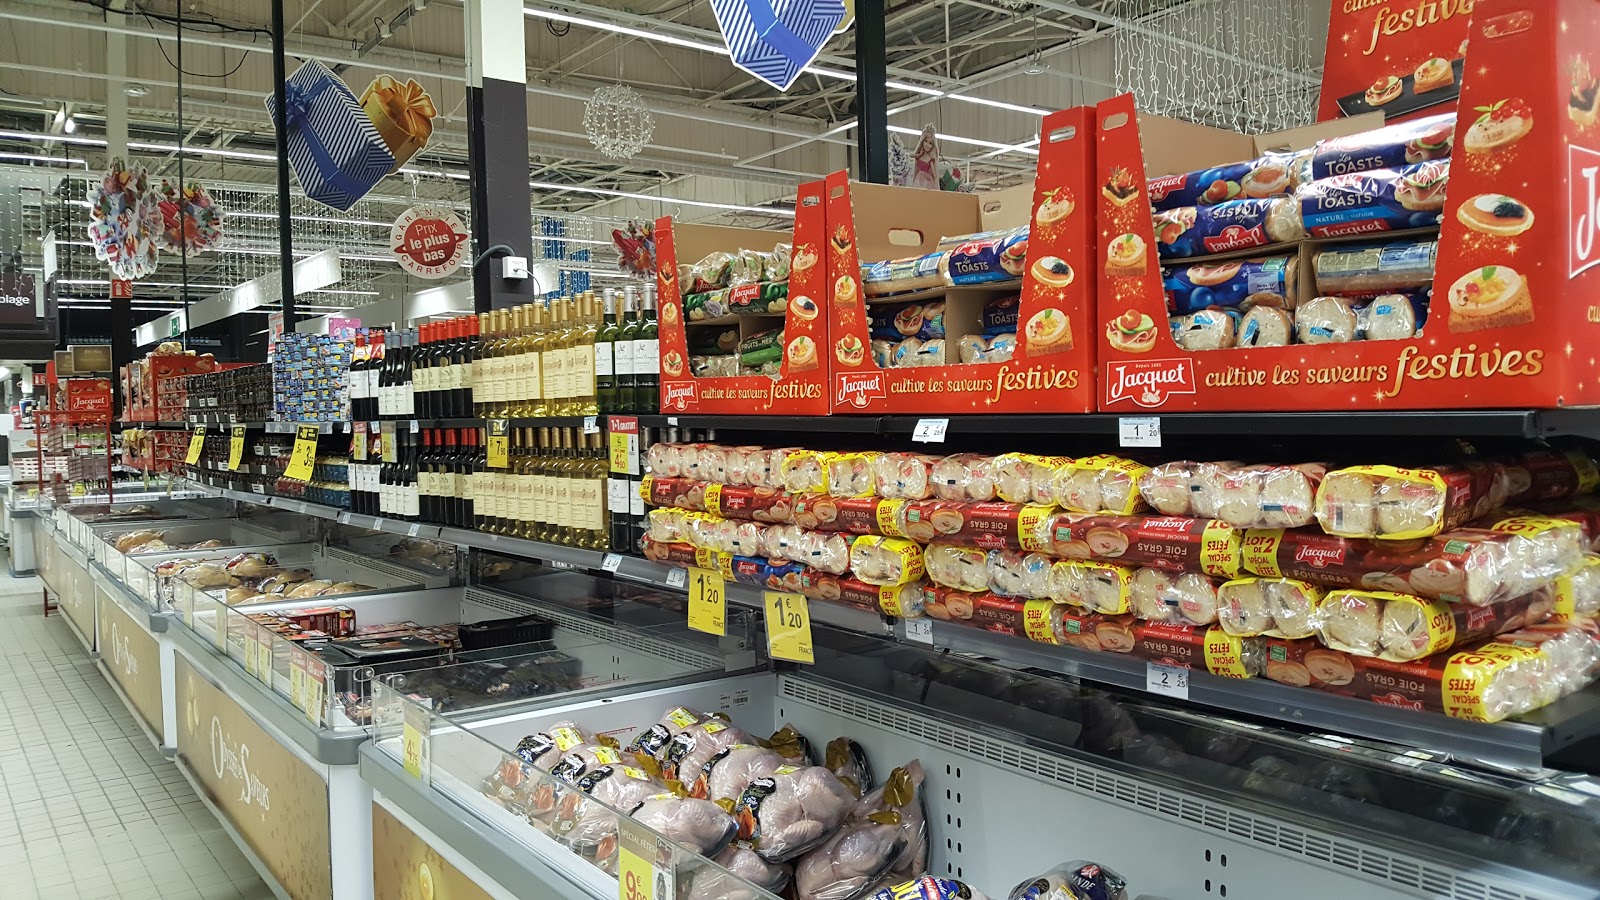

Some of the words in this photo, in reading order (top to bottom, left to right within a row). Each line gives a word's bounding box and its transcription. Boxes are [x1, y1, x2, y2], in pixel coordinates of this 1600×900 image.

[1325, 155, 1384, 176] TOASTS
[1147, 174, 1185, 193] acquet
[1315, 191, 1373, 210] TOASTS
[1213, 203, 1260, 220] TOASTS
[1315, 213, 1345, 224] NATURE
[415, 223, 438, 236] Prix
[1210, 223, 1263, 250] Jacquet
[410, 238, 422, 250] le
[424, 232, 450, 250] plus
[401, 243, 464, 275] CARREFOUR
[422, 249, 446, 263] bas
[955, 260, 990, 273] TOASTS
[730, 286, 758, 302] Jacquet
[1205, 365, 1267, 387] cultive
[1271, 364, 1300, 385] les
[1305, 364, 1388, 384] saveurs
[1385, 343, 1544, 398] festives
[890, 377, 926, 394] cultive
[927, 376, 944, 392] les
[946, 377, 994, 392] saveurs
[990, 364, 1080, 404] festives
[1110, 362, 1187, 399] Jacquet
[665, 385, 695, 405] Jacquet
[700, 386, 725, 400] cultive
[725, 385, 737, 399] les
[738, 388, 768, 399] saveurs
[768, 379, 823, 408] festives
[838, 375, 880, 402] Jacquet
[73, 396, 105, 409] Jacquet
[922, 426, 930, 435] 2
[1133, 424, 1140, 437] 1
[1148, 429, 1158, 437] 20
[970, 520, 990, 528] GRAS
[991, 521, 1008, 530] FOIE
[1143, 518, 1195, 533] Jacquet
[911, 544, 921, 556] 2
[1137, 542, 1158, 551] GRAS
[1160, 544, 1187, 556] FOIE
[1207, 540, 1229, 551] FÊTES
[1245, 536, 1264, 546] LOT
[1262, 537, 1276, 554] 2
[1208, 553, 1232, 563] SPÉCIAL
[1296, 545, 1342, 561] Jacquet
[1206, 564, 1216, 575] 2
[1255, 564, 1277, 576] FÊTES
[1293, 569, 1318, 581] FOIE
[1320, 573, 1351, 583] GRAS
[697, 573, 705, 601] 1
[706, 575, 711, 586] €
[707, 588, 719, 605] 20
[785, 598, 792, 609] €
[774, 596, 786, 627] 1
[979, 609, 998, 618] GRAS
[1000, 612, 1015, 621] FOIE
[1466, 606, 1495, 629] Jacquet
[712, 620, 724, 629] FRANCE
[788, 612, 802, 629] 20
[1431, 615, 1444, 629] LOT
[913, 623, 918, 633] 1
[798, 646, 813, 656] FRANCE
[1143, 641, 1168, 651] GRAS
[1170, 645, 1192, 656] FOIE
[1209, 643, 1230, 655] FÊTES
[1212, 656, 1235, 666] SPÉCIAL
[1161, 672, 1169, 685] 2
[1176, 680, 1186, 688] 25
[1365, 672, 1395, 687] GRAS
[1399, 678, 1425, 693] FOIE
[1448, 679, 1477, 695] FÊTES
[1451, 695, 1481, 706] SPÉCIAL
[406, 739, 413, 760] 4
[411, 752, 418, 767] 75
[620, 828, 640, 844] SPÉCIAL
[640, 839, 656, 854] FÊTES
[625, 870, 637, 900] 9
[636, 875, 642, 888] €
